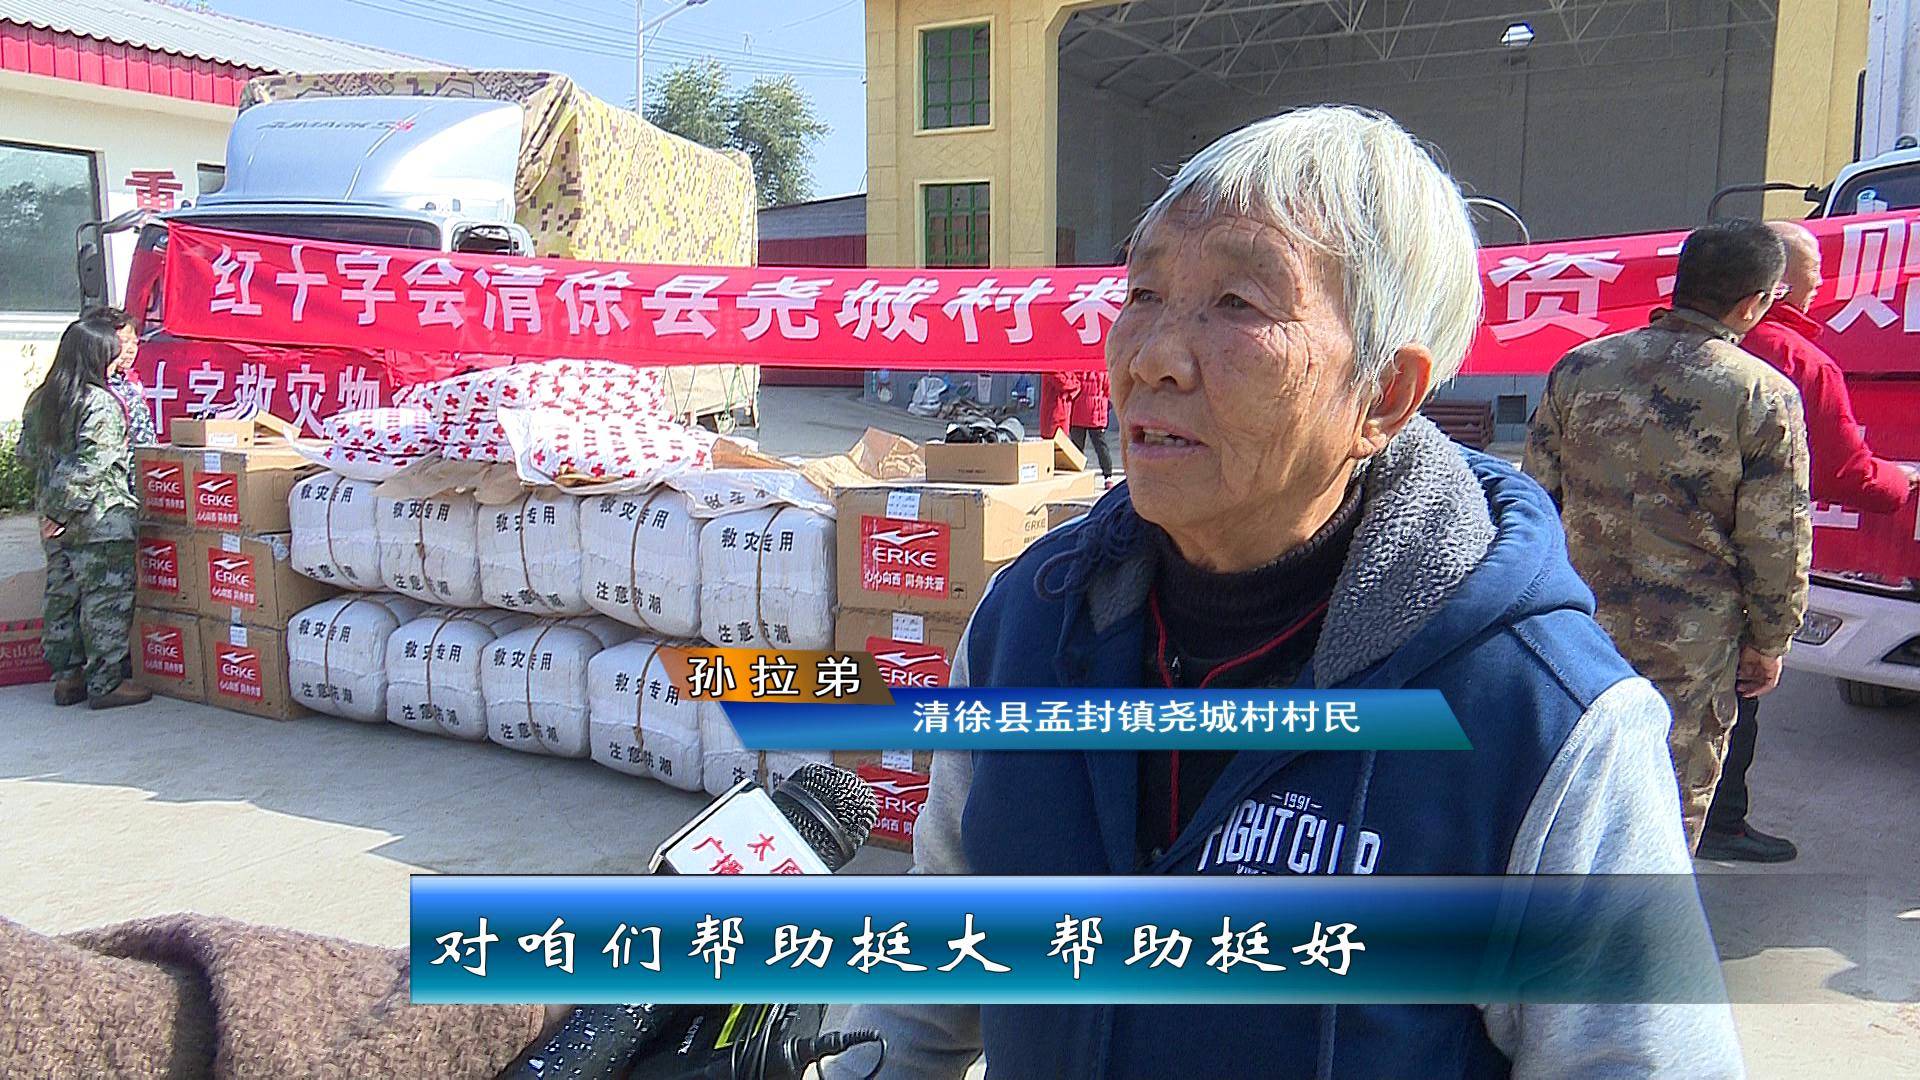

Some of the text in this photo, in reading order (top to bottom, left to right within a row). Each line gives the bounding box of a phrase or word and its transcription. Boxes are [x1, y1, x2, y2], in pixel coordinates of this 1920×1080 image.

[147, 481, 181, 495] ERKE
[199, 493, 234, 508] ERKE
[872, 546, 937, 568] ERKE
[215, 570, 251, 587] ERKE
[222, 663, 257, 680] ERKE
[1283, 791, 1311, 811] 1991
